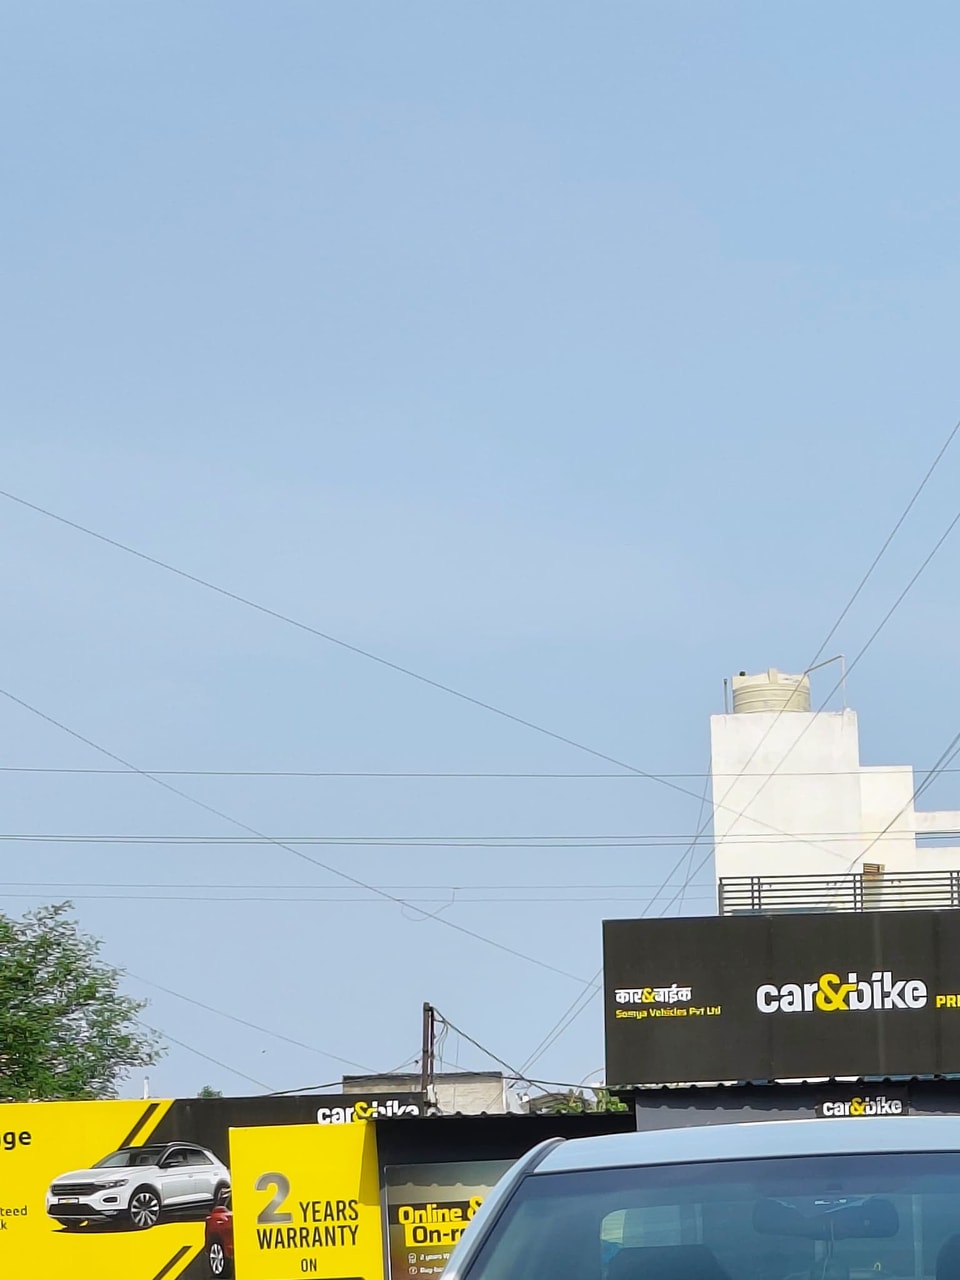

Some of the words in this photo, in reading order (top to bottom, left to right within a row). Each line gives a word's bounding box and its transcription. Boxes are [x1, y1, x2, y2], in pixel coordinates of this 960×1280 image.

[756, 971, 928, 1013] car&bike
[822, 1096, 902, 1116] car&bike
[255, 1172, 293, 1225] 2
[299, 1200, 359, 1223] YEARS
[398, 1203, 463, 1225] Online
[256, 1224, 359, 1250] WARRANTY
[301, 1258, 317, 1272] ON
